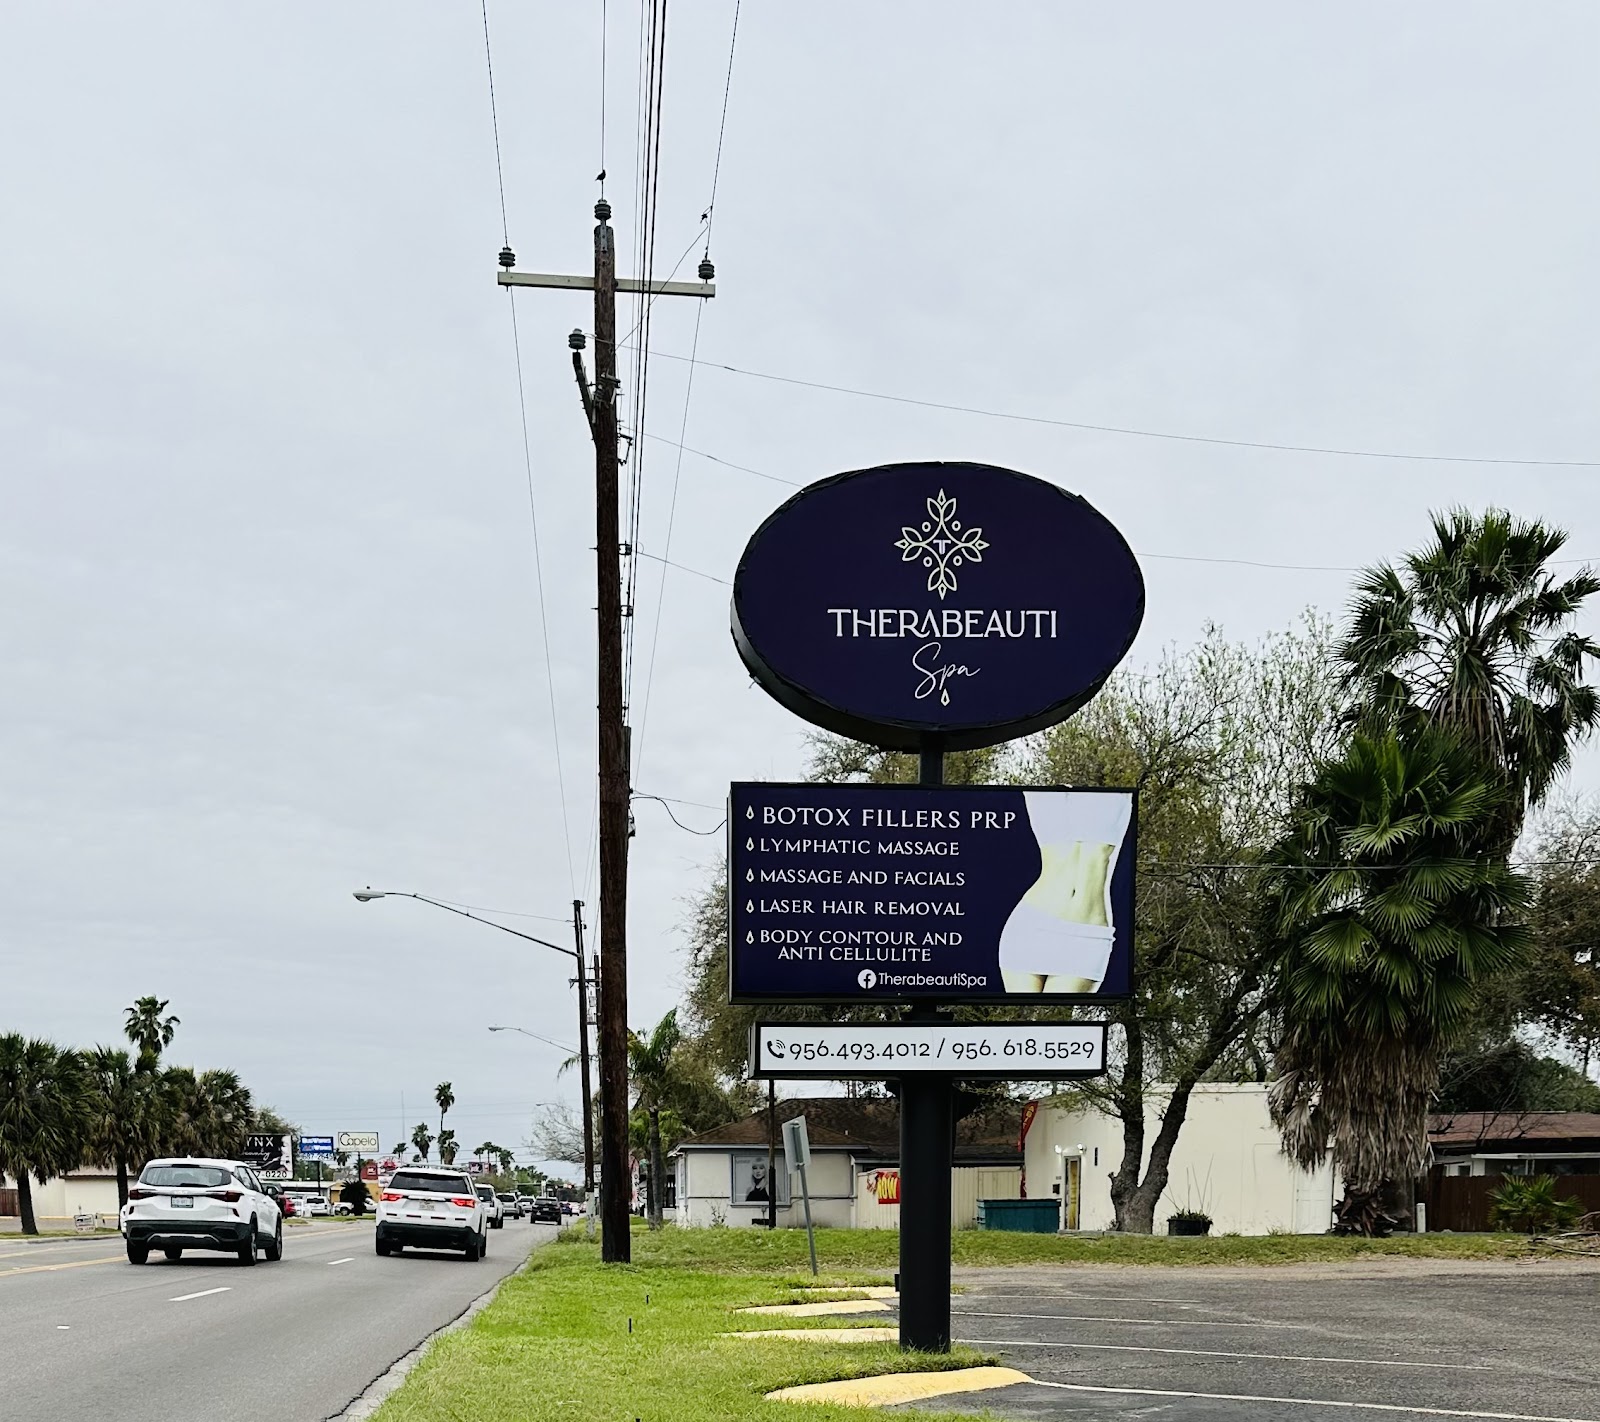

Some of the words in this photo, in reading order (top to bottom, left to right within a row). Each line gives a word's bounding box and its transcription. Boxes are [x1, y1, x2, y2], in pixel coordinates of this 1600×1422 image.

[827, 608, 1058, 639] THERABEAUTI
[912, 641, 981, 700] Spa
[763, 806, 852, 827] BOTOX
[862, 809, 961, 829] FILLERS
[971, 811, 1016, 829] PRP
[760, 838, 871, 856] LYMPHATIC
[877, 840, 960, 856] MASSAGE
[760, 868, 843, 885] MASSAGE
[847, 870, 888, 886] AND
[894, 871, 966, 887] FACIALS
[760, 899, 815, 915] LASER
[822, 900, 867, 915] HAIR
[874, 901, 965, 917] REMOVAL
[760, 930, 812, 946] BODY
[819, 930, 917, 946] CONTOUR
[922, 931, 963, 946] AND
[777, 946, 824, 961] ANTI
[829, 946, 932, 962] CELLULITE
[878, 971, 988, 989] TherabeautiSpa
[789, 1039, 931, 1061] 956.493.4012
[246, 1136, 274, 1147] YNX
[340, 1132, 377, 1148] Capelo
